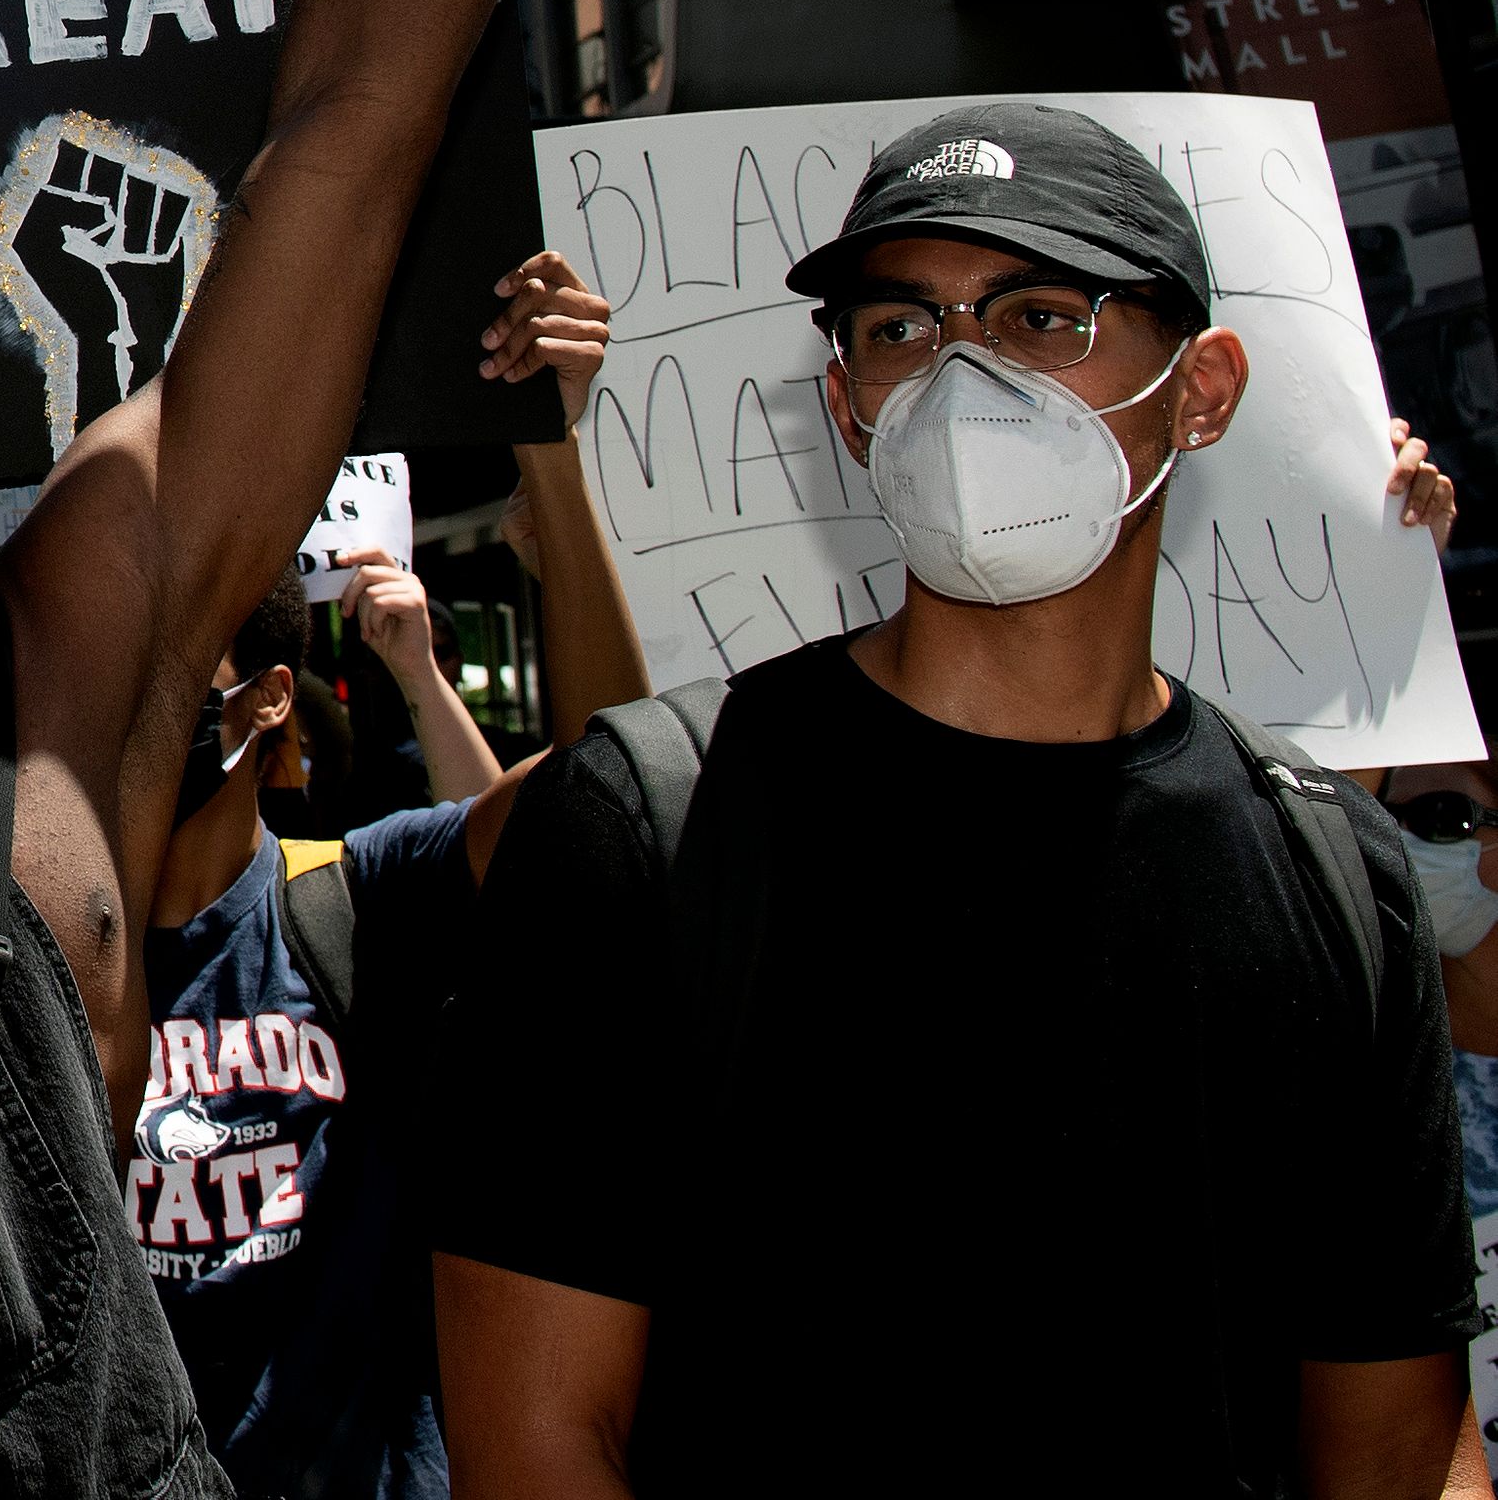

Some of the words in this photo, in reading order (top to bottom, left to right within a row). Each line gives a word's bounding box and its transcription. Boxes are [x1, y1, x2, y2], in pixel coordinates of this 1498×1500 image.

[1182, 28, 1347, 82] MALL
[937, 138, 978, 155] THE
[906, 149, 976, 179] NORTH
[918, 162, 973, 182] FACE
[571, 140, 876, 322] BLAC
[1159, 140, 1333, 300] ES
[233, 1120, 279, 1146] 1933
